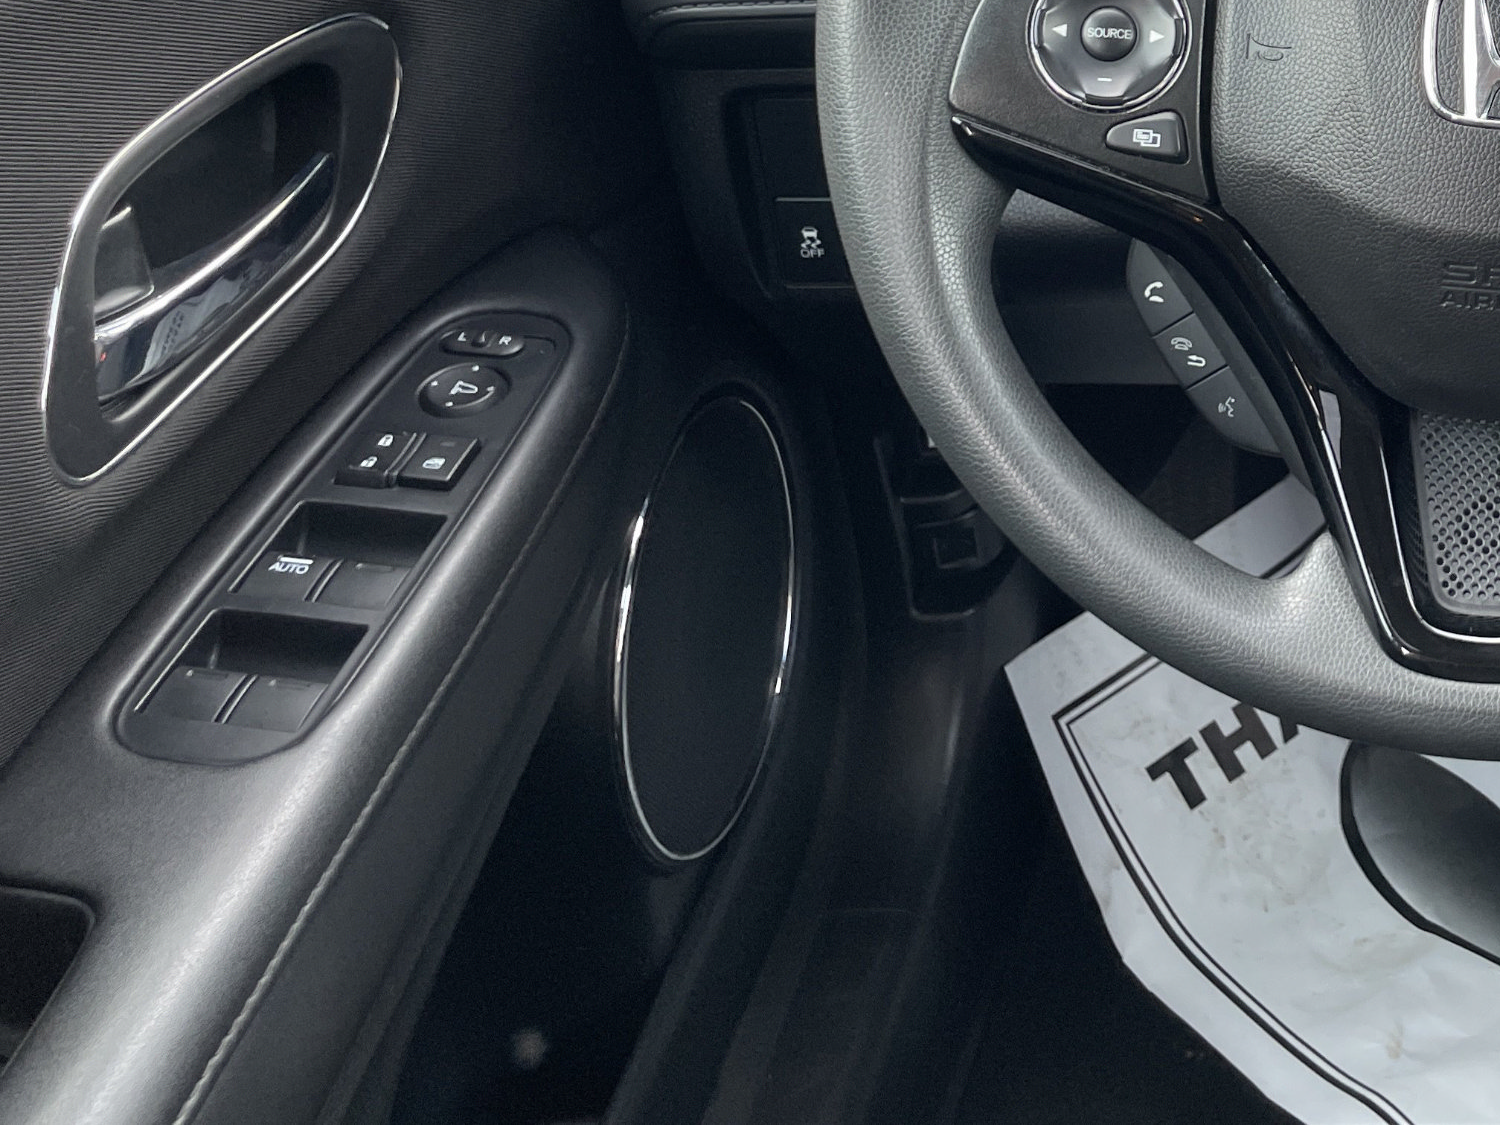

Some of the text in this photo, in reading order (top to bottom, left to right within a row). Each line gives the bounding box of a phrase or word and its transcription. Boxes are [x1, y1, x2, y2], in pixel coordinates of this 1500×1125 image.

[1086, 28, 1133, 40] SOURCE
[800, 248, 825, 259] OFF
[498, 335, 513, 346] R
[268, 561, 310, 575] AUTO
